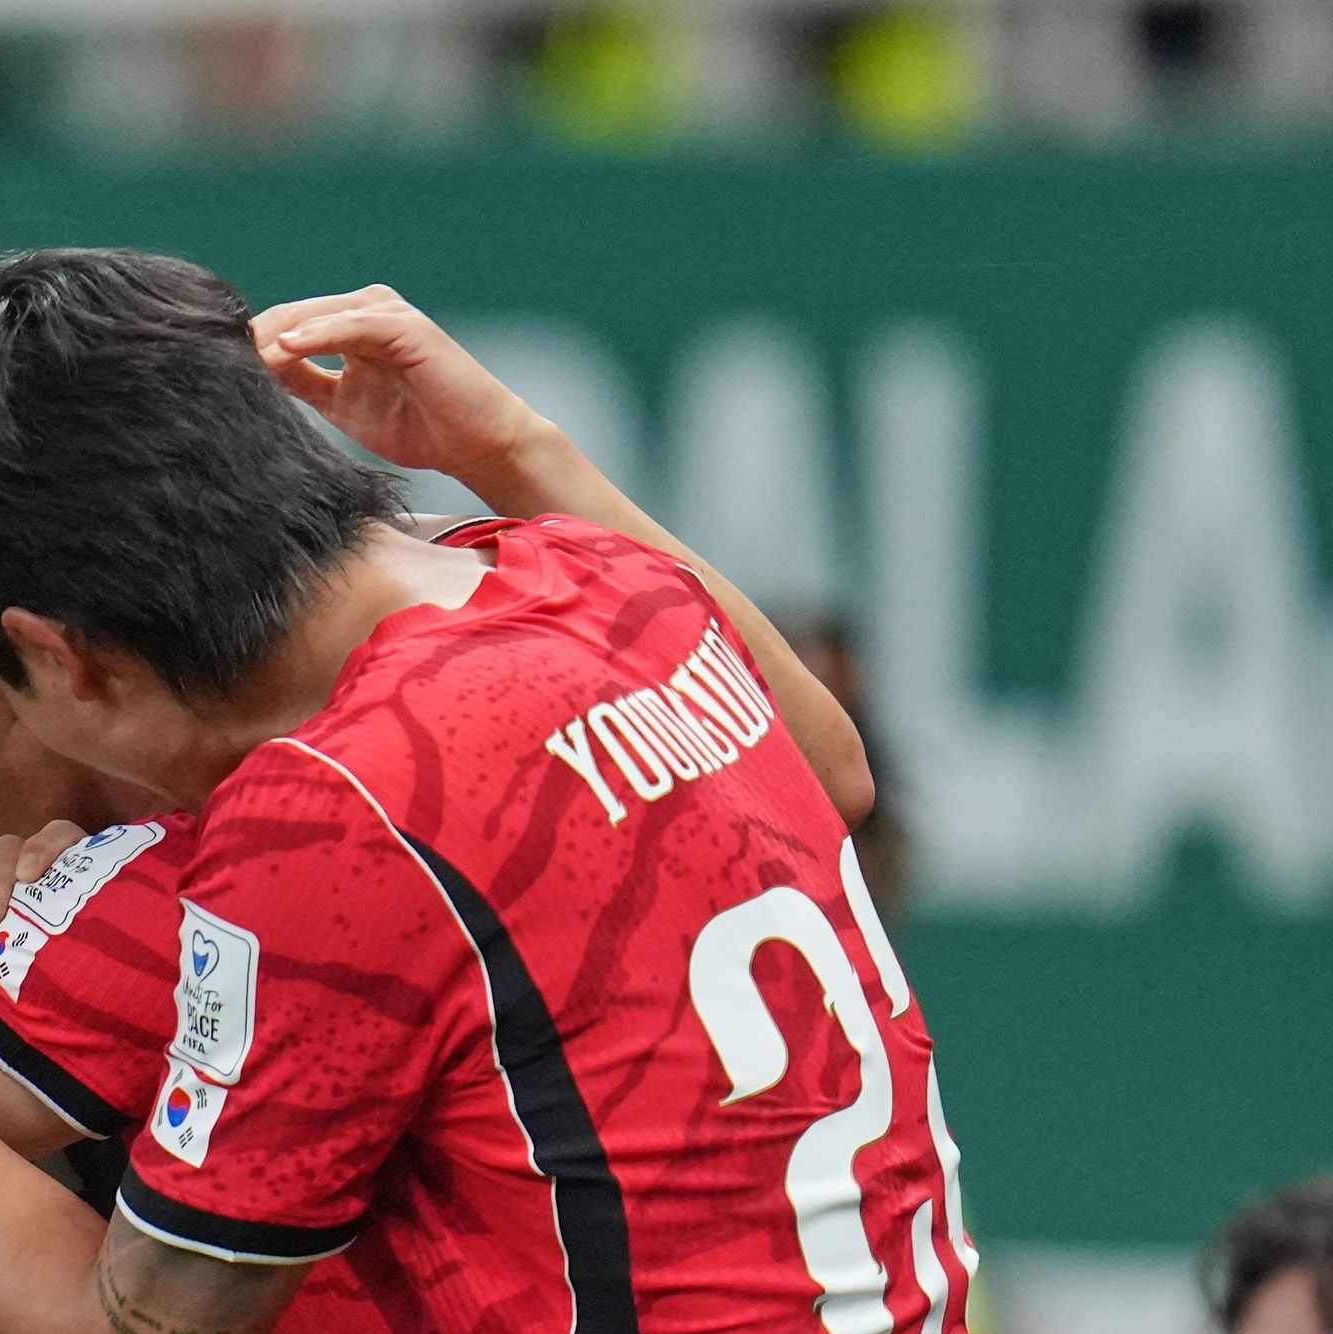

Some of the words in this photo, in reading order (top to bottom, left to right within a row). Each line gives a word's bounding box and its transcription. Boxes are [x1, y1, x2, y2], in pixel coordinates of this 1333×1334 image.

[25, 885, 43, 903] FIFA
[204, 990, 223, 1013] For
[188, 1001, 220, 1042] PACE
[182, 1034, 206, 1055] FIFA
